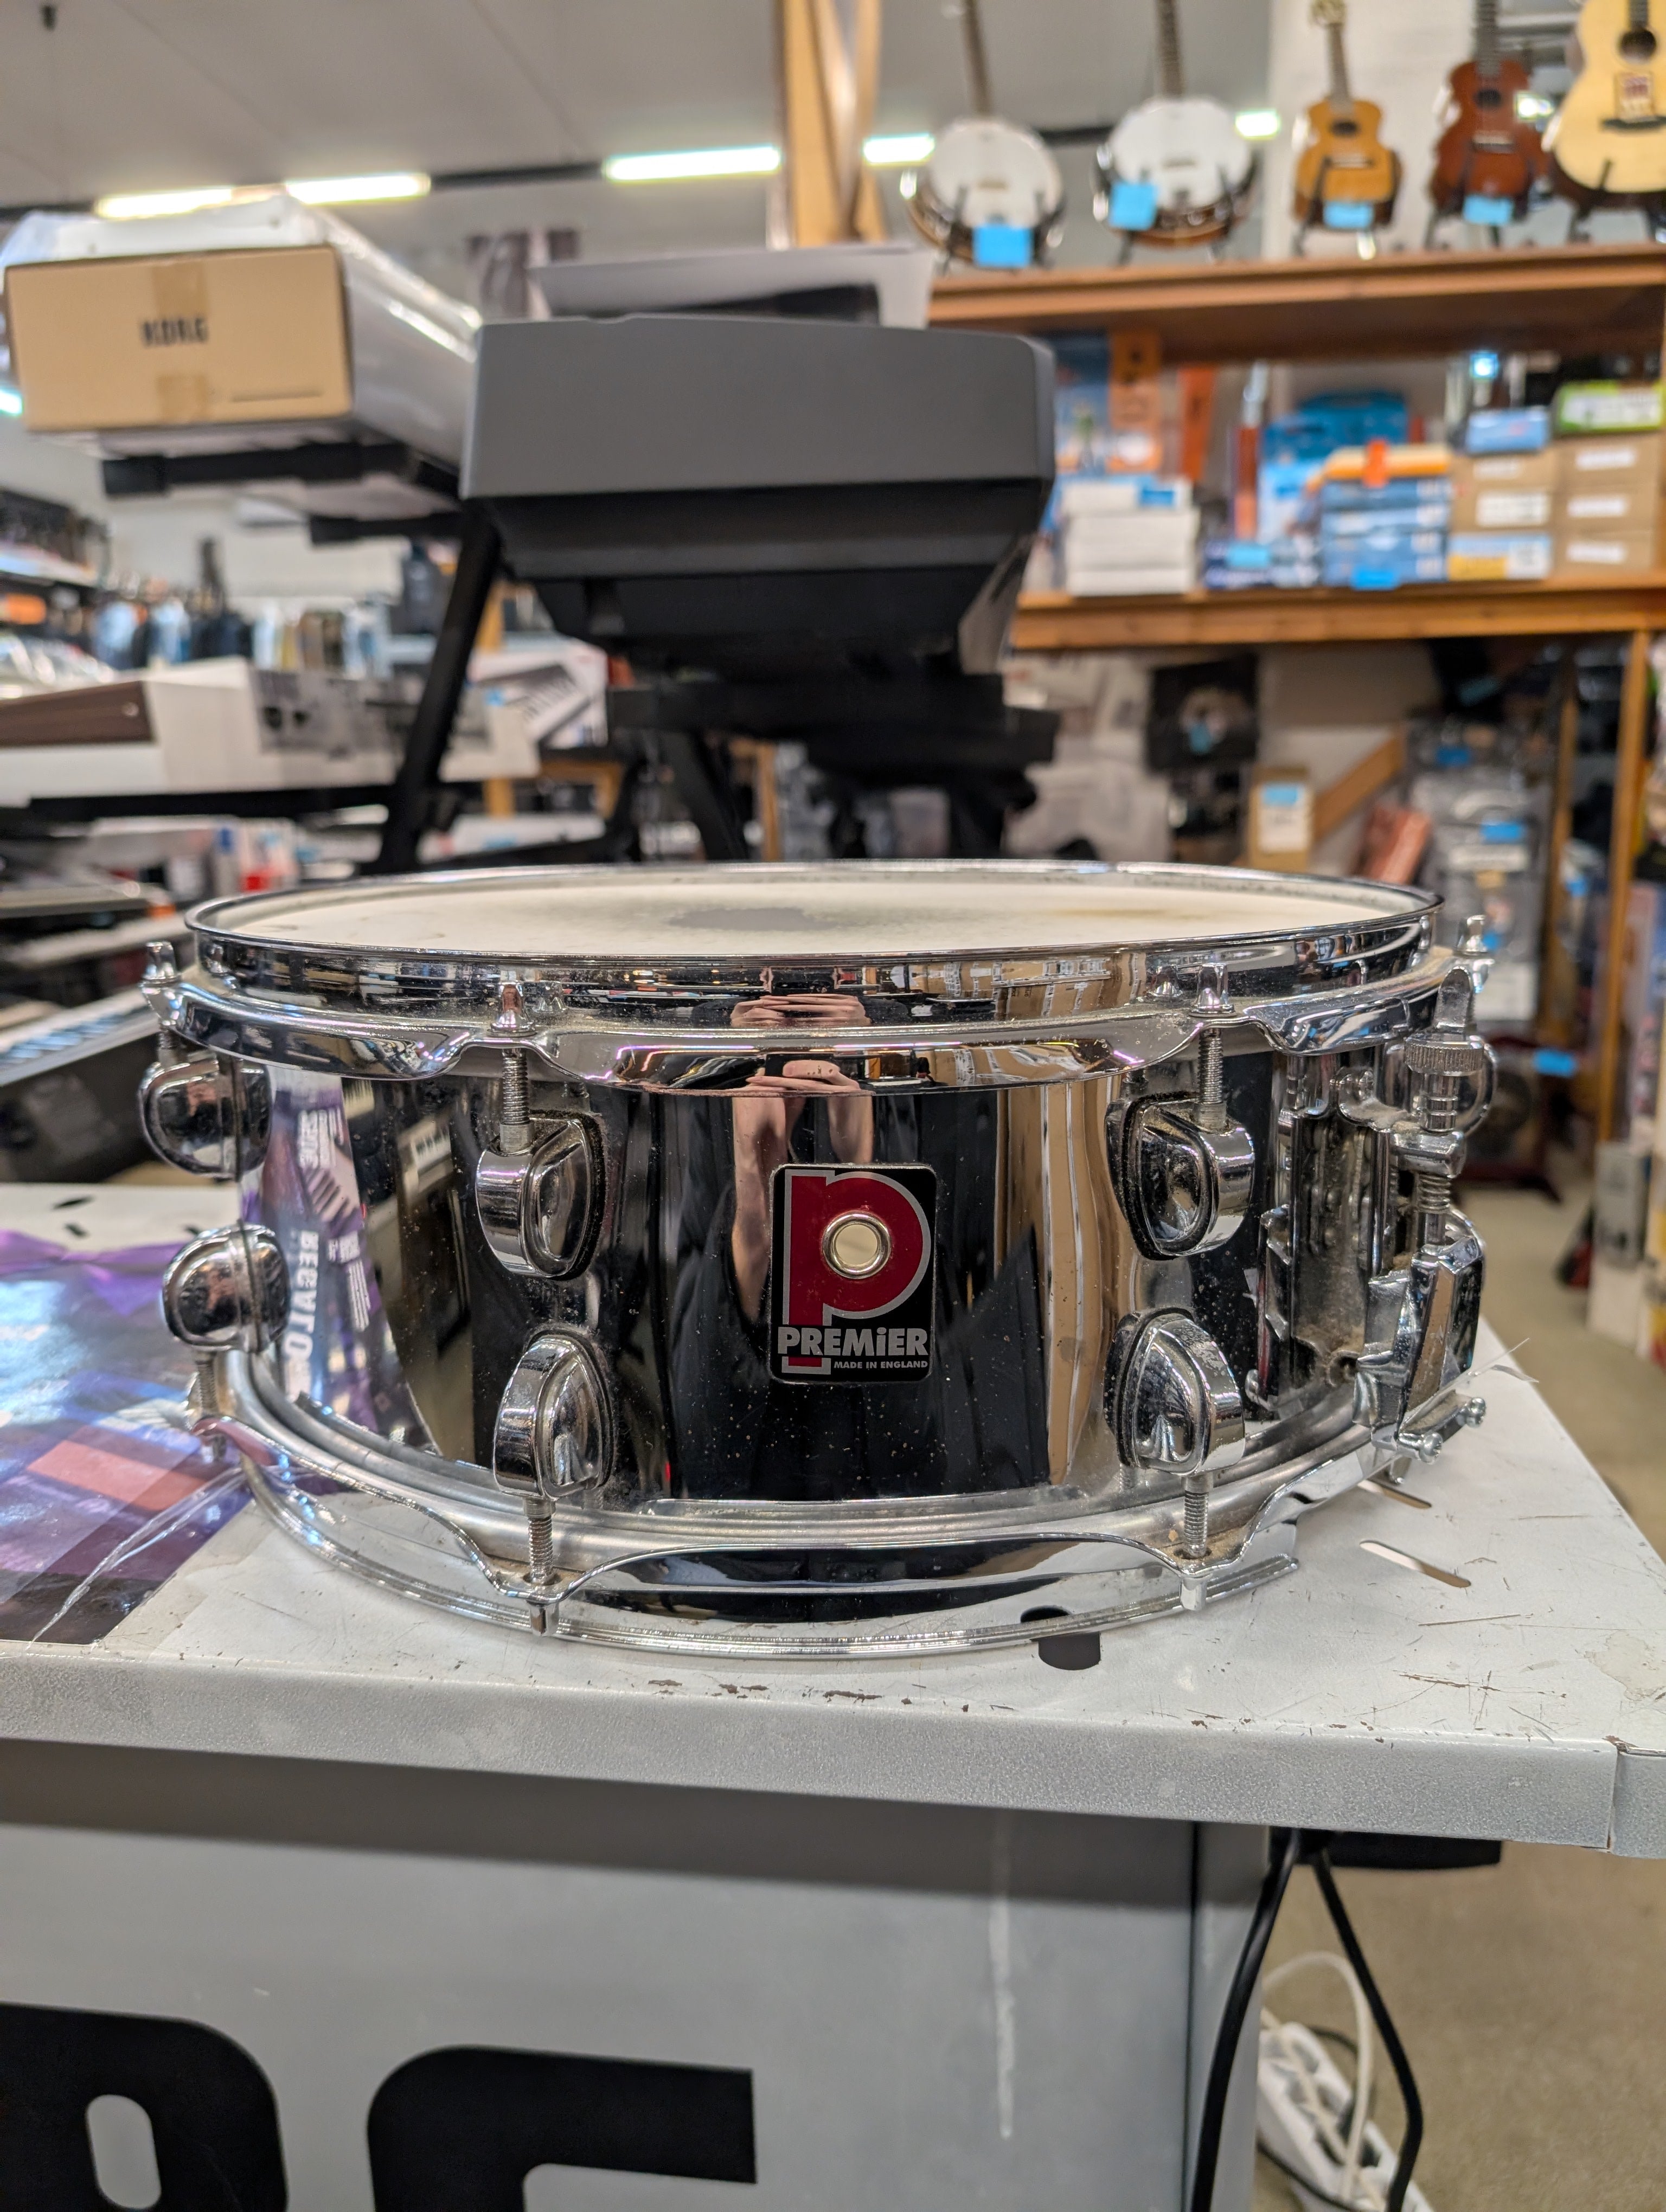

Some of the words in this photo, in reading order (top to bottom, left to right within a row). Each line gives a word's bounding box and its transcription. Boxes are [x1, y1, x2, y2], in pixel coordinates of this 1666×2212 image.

[142, 318, 209, 348] KORG
[834, 1361, 862, 1369] MADE
[880, 1360, 928, 1369] ENGLAND
